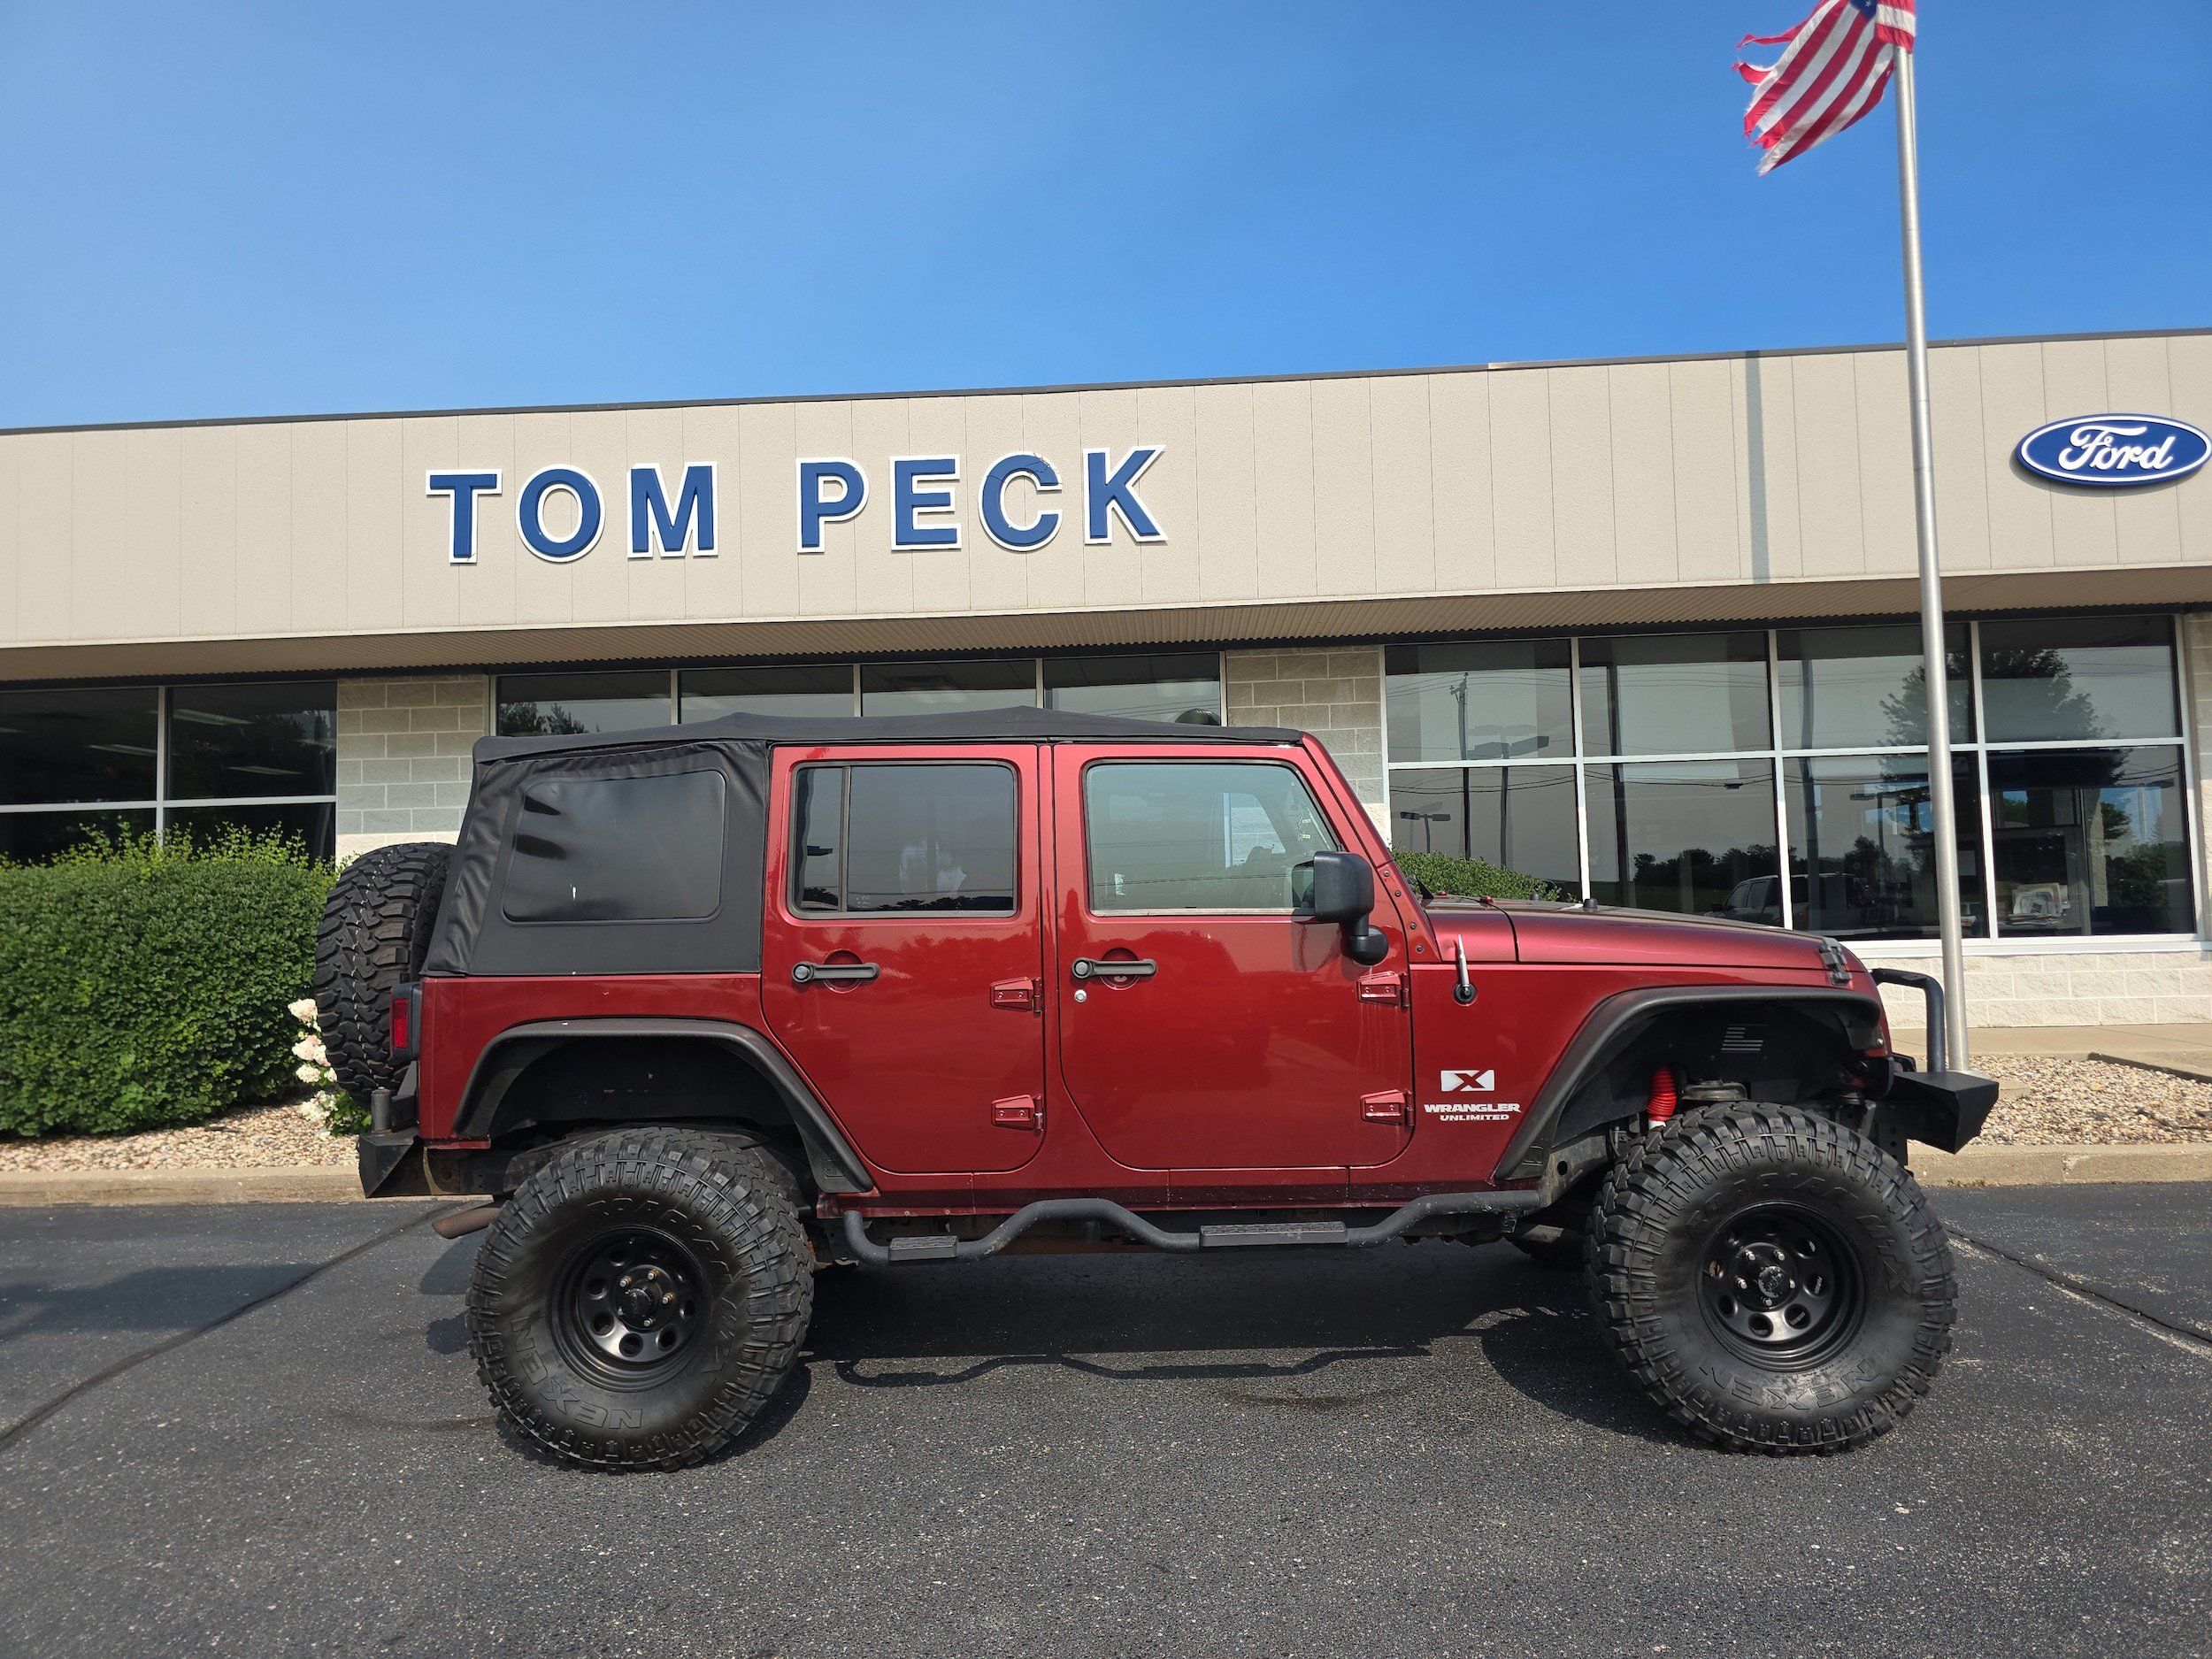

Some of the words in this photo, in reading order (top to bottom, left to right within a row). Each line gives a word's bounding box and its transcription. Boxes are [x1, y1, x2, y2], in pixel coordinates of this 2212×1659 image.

[2058, 425, 2177, 471] Ford
[426, 461, 718, 563] TOM
[795, 444, 1169, 554] PECK
[1448, 1069, 1492, 1092] X
[1423, 1103, 1522, 1114] WRANGLER
[510, 1317, 643, 1430] NEXEN
[1699, 1357, 1882, 1411] NEXEN
